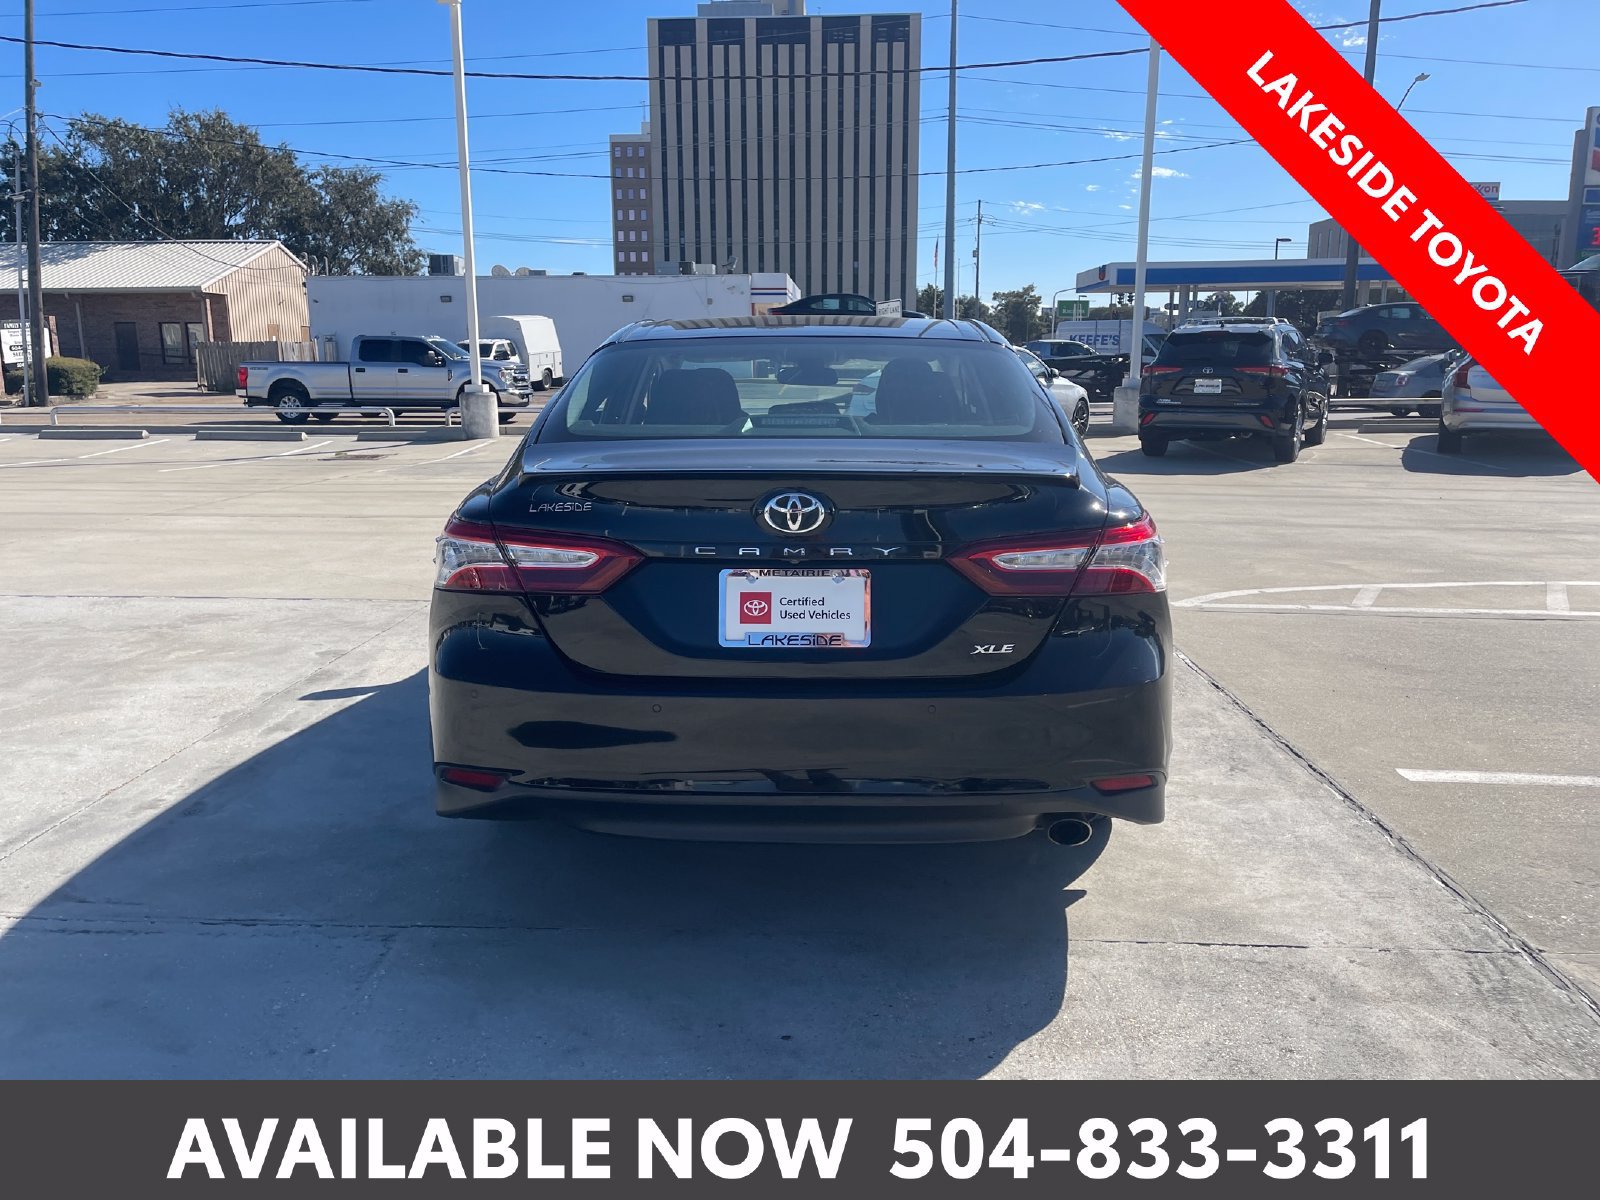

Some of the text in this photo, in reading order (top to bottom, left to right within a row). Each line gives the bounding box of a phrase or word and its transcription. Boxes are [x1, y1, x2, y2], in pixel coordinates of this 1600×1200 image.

[1069, 334, 1120, 346] KEEFE'S
[695, 546, 900, 556] CAMRY
[759, 568, 830, 577] METAIRIE
[779, 597, 825, 606] Certified
[779, 610, 851, 620] Used Vehicles
[970, 644, 1016, 655] XLE
